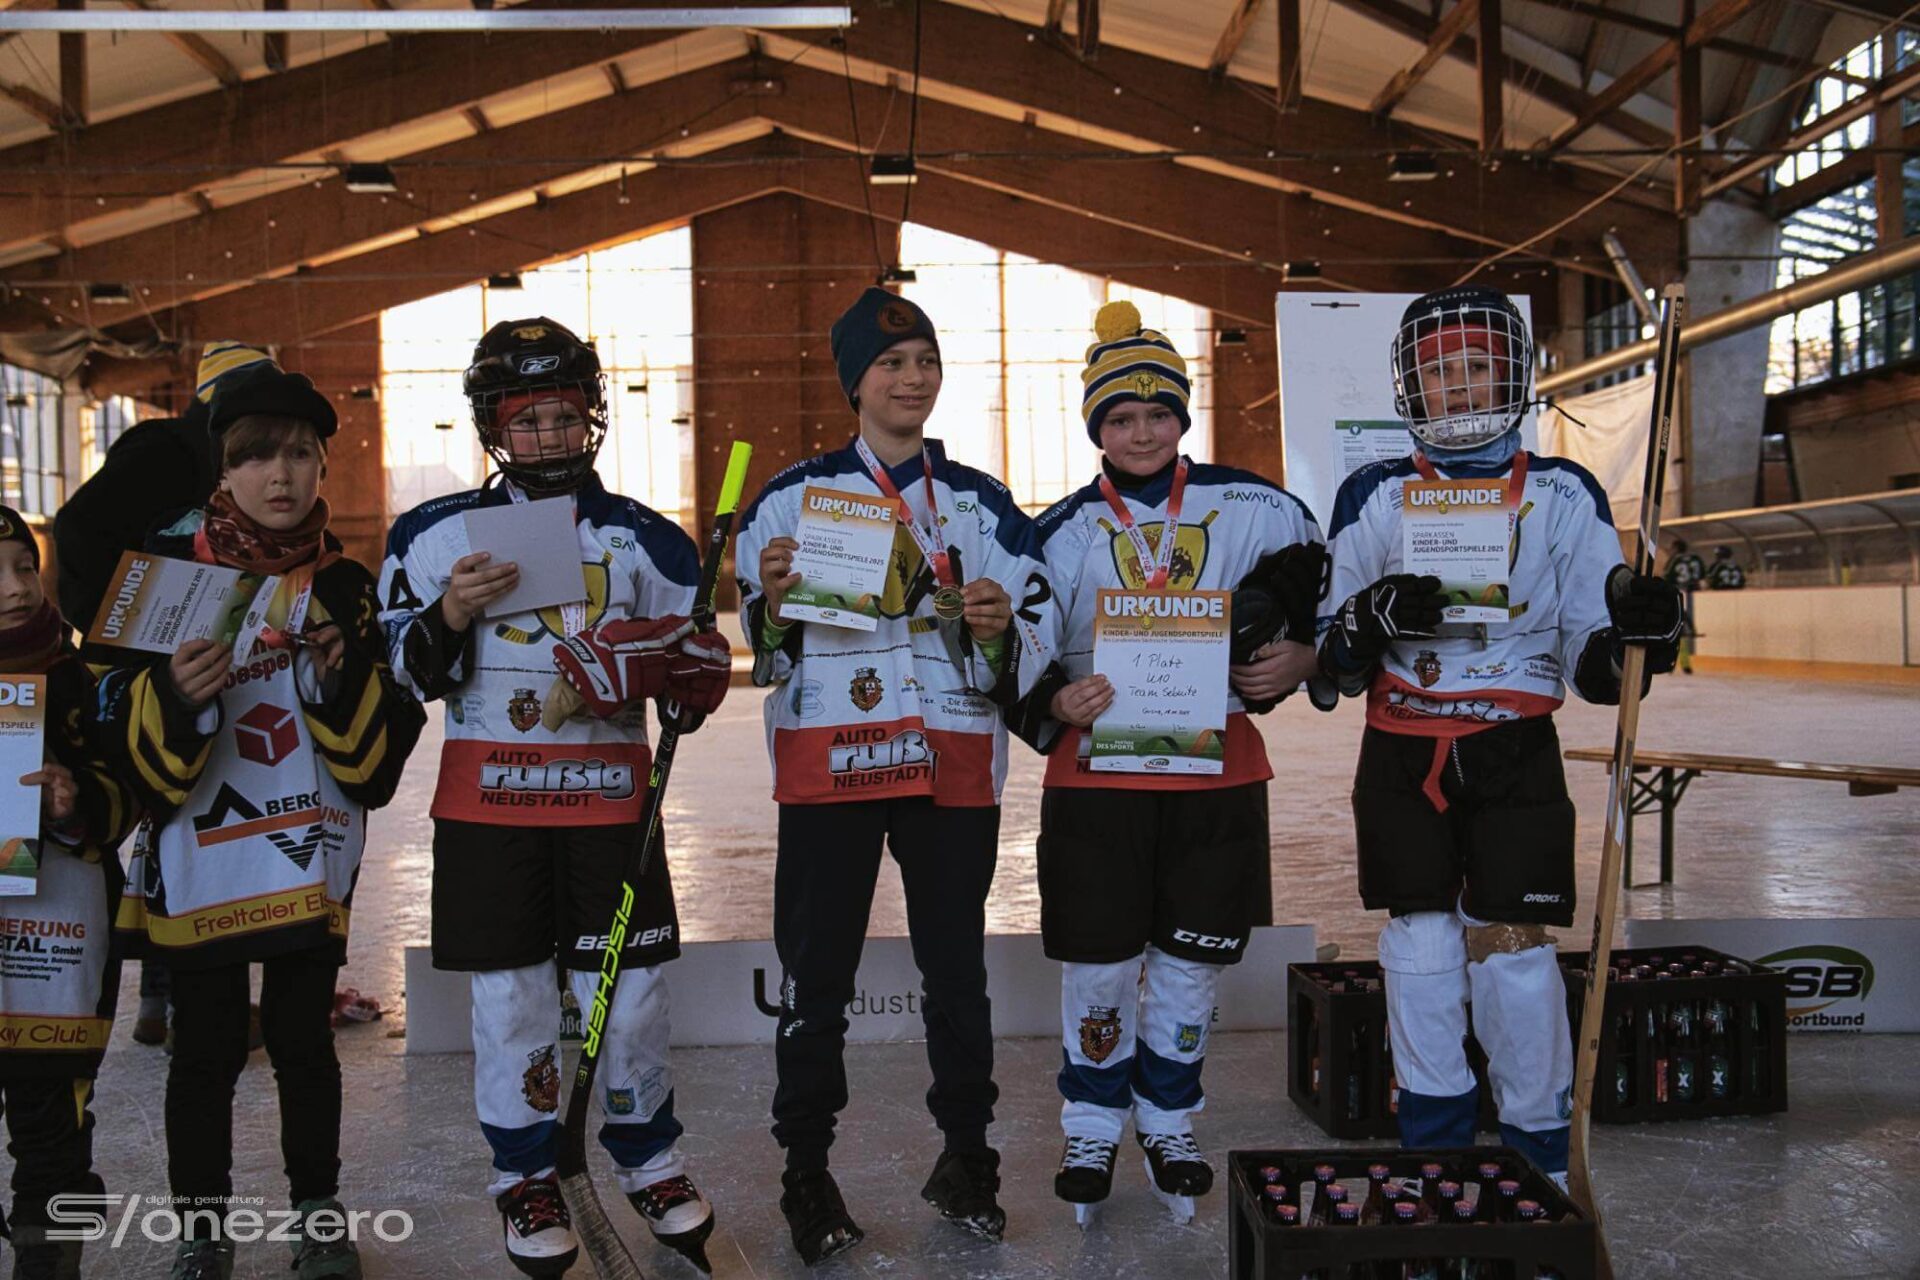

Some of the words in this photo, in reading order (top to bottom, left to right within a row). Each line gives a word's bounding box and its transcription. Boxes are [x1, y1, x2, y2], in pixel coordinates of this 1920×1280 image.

[1223, 490, 1279, 509] SAVAYU
[1410, 489, 1502, 506] URKUNDE
[809, 495, 893, 522] URKUNDE
[101, 559, 150, 639] URKUNDE
[1015, 572, 1052, 625] 2
[1103, 595, 1224, 618] URKUNDE
[1151, 630, 1224, 638] JUGENDSPORTSPIELE
[1128, 685, 1159, 698] Team
[832, 728, 887, 746] AUTO
[487, 751, 542, 765] AUTO
[480, 758, 636, 800] rußig
[833, 765, 930, 789] NEUSTADT
[480, 792, 594, 807] NEUSTADT
[1173, 928, 1240, 950] CCM
[51, 945, 83, 955] GmbH
[582, 880, 635, 1057] FISCHER
[1780, 966, 1864, 998] SB
[30, 1024, 88, 1044] Club
